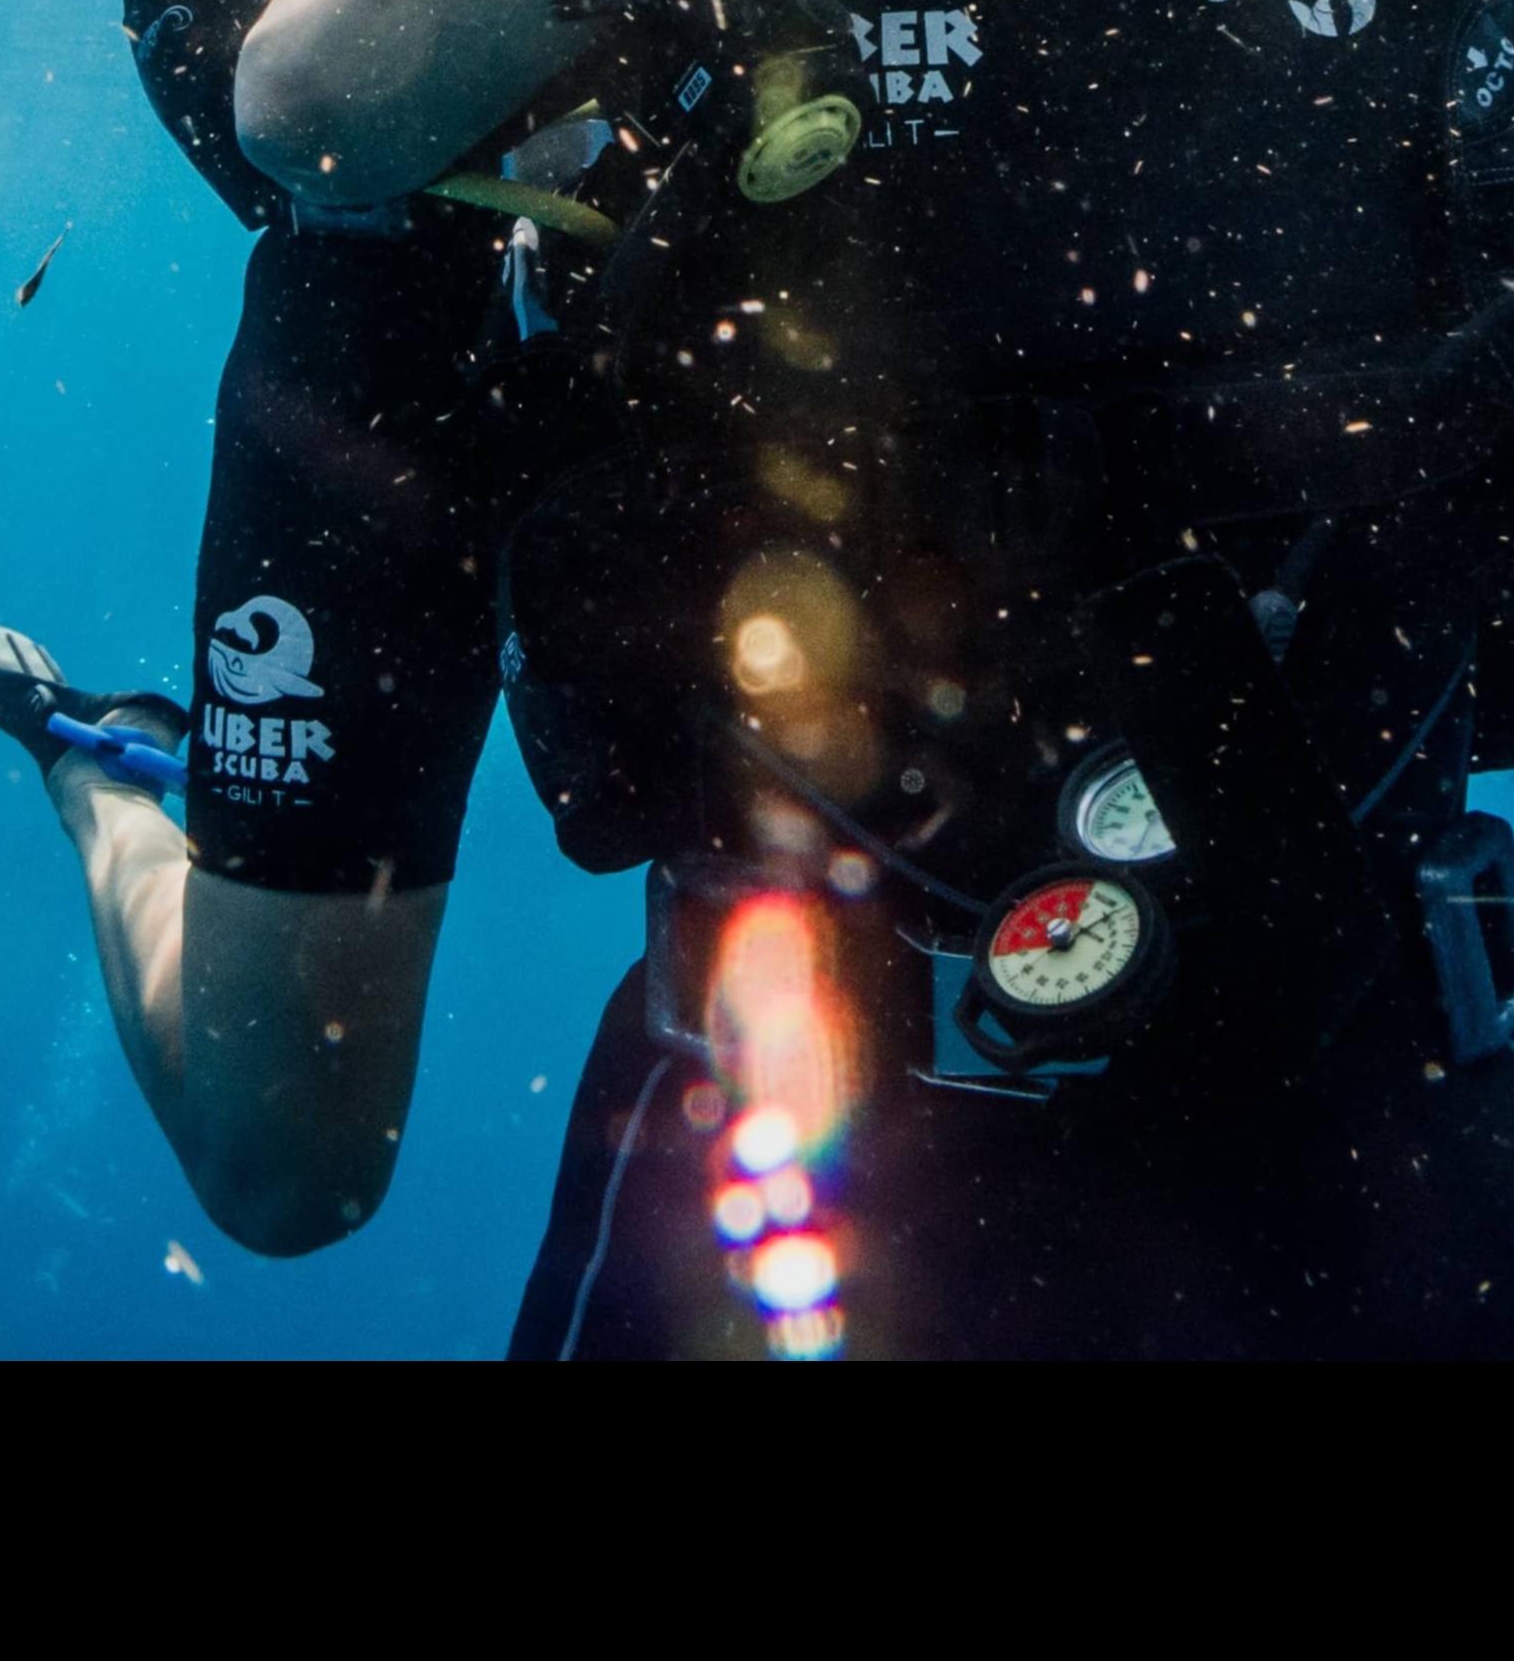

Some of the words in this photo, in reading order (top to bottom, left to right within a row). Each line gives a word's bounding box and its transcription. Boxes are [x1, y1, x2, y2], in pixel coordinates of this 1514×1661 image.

[203, 704, 336, 762] UBER
[214, 751, 310, 784] SCUBA
[227, 785, 262, 804] GILI
